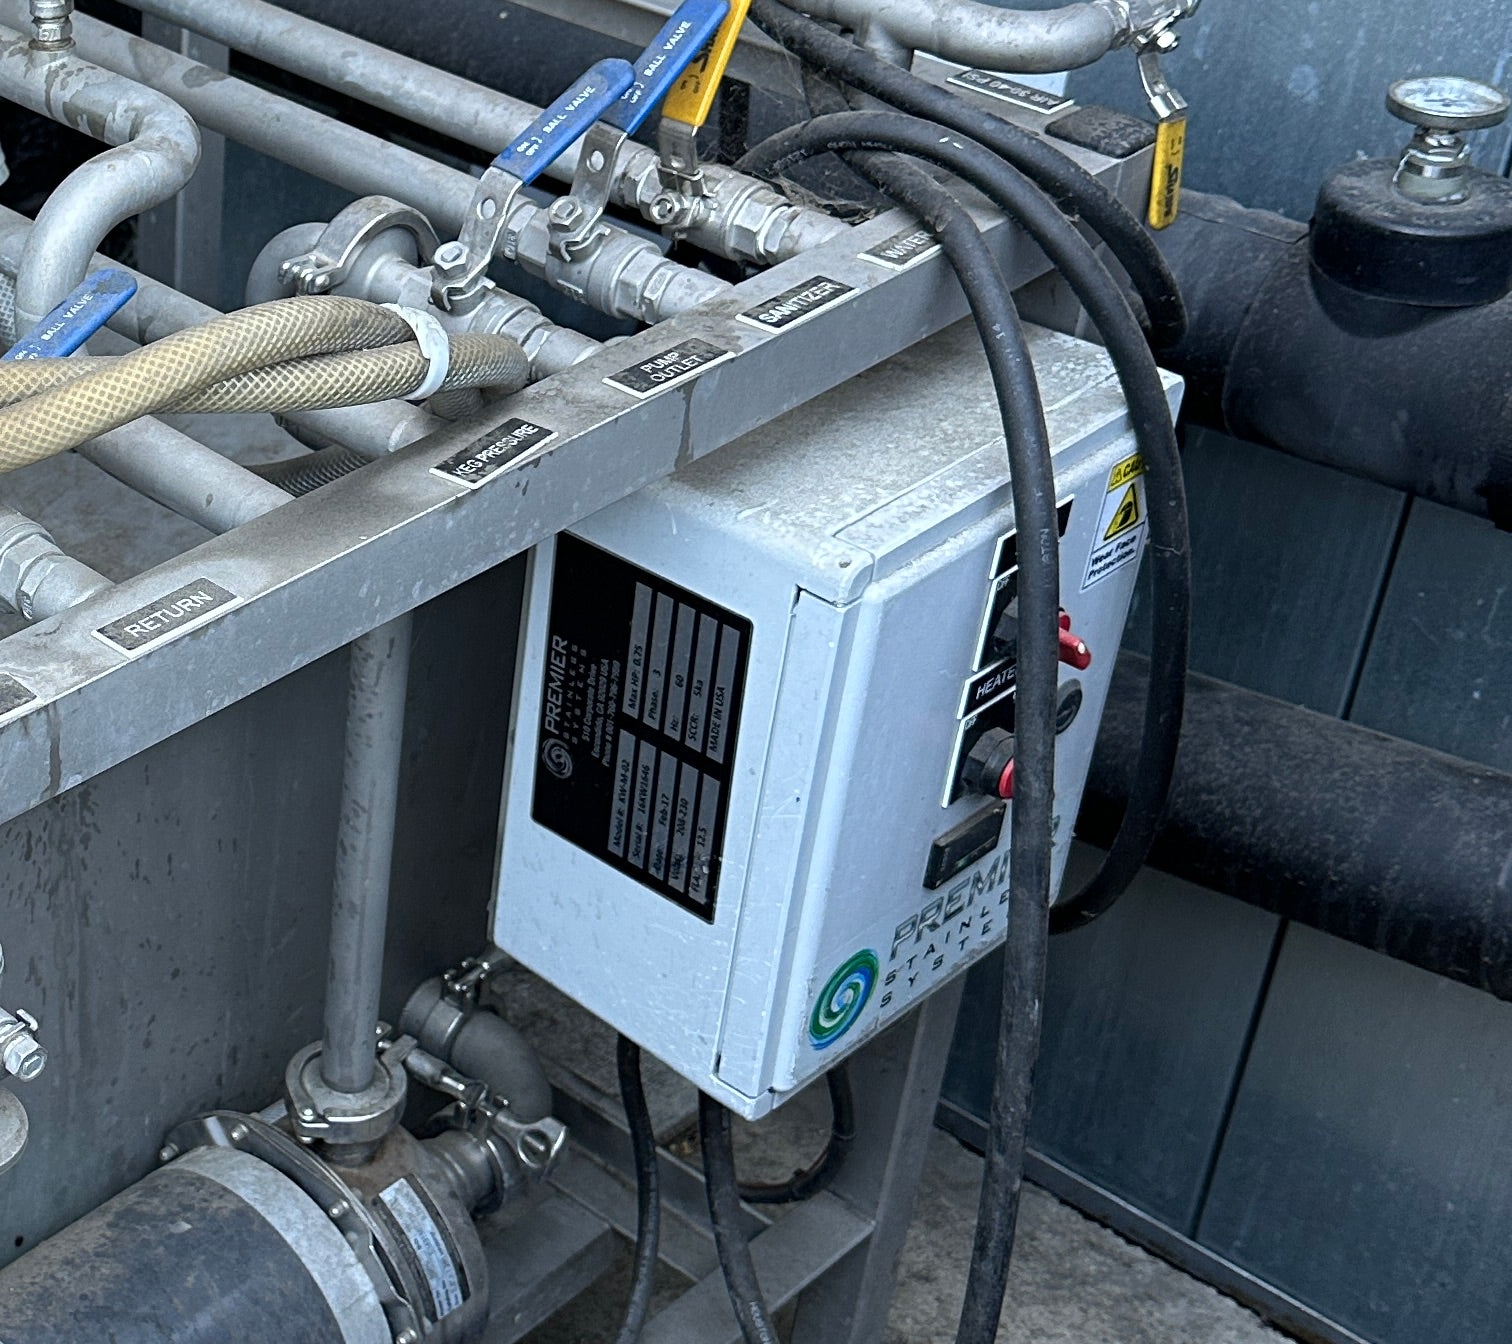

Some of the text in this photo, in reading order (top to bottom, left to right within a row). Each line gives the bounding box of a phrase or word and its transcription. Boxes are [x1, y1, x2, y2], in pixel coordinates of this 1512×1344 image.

[643, 20, 692, 77] BALL VALVE
[542, 85, 597, 134] BALL VALVE
[1029, 93, 1060, 107] AIR
[879, 229, 935, 260] WATER
[40, 293, 94, 341] BALL VALVE
[758, 280, 841, 324] SANITIZER
[639, 350, 680, 376] PUMP
[648, 353, 707, 385] OUTLET
[451, 423, 540, 478] KEG PRESSURE
[123, 589, 215, 639] RETURN
[543, 632, 568, 736] PREMIER
[627, 684, 638, 711] Max
[974, 662, 1018, 701] HEATE
[708, 683, 726, 754] MADE IN USA
[696, 824, 707, 848] 12.5
[884, 887, 1011, 987] STAINLE
[879, 918, 994, 1008] SYSTE
